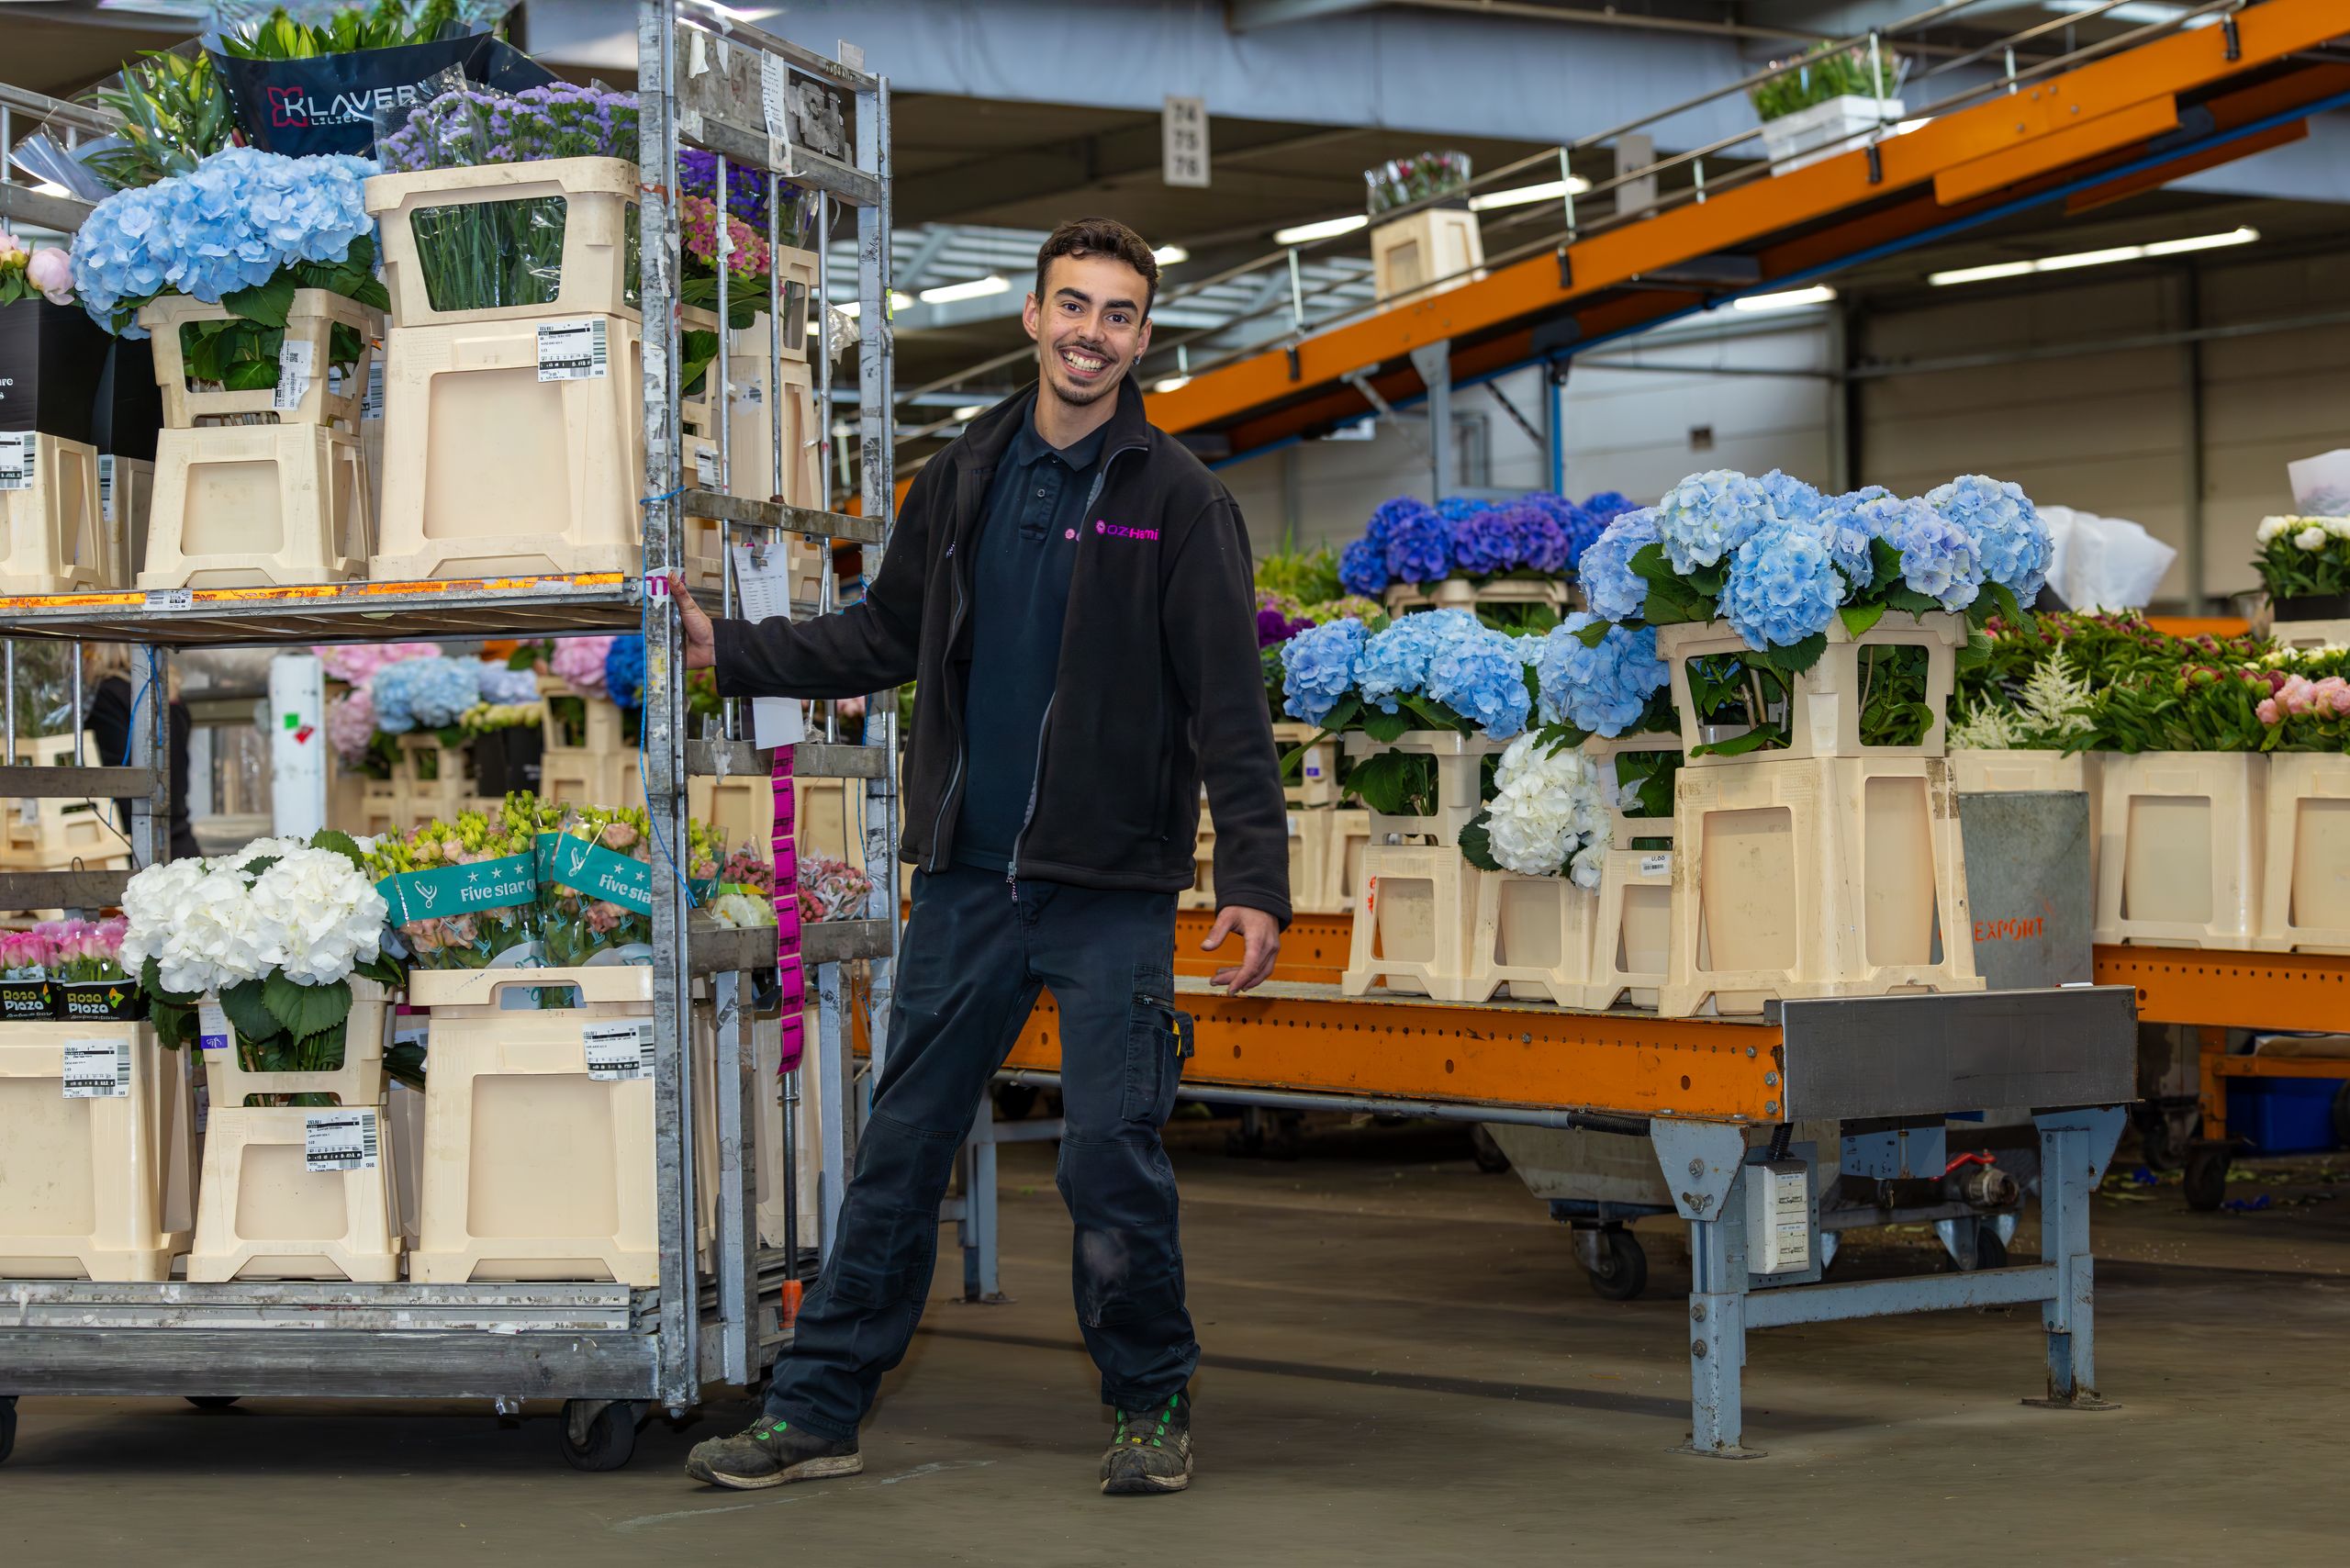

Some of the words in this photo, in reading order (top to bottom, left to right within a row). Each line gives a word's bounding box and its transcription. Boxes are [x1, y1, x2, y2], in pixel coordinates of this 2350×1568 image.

[284, 84, 417, 117] KLAVER
[461, 885, 493, 902] Five
[599, 873, 629, 896] Five
[1975, 916, 2044, 942] EXPORT
[5, 1001, 44, 1011] Plaza
[69, 1002, 109, 1014] Plaza
